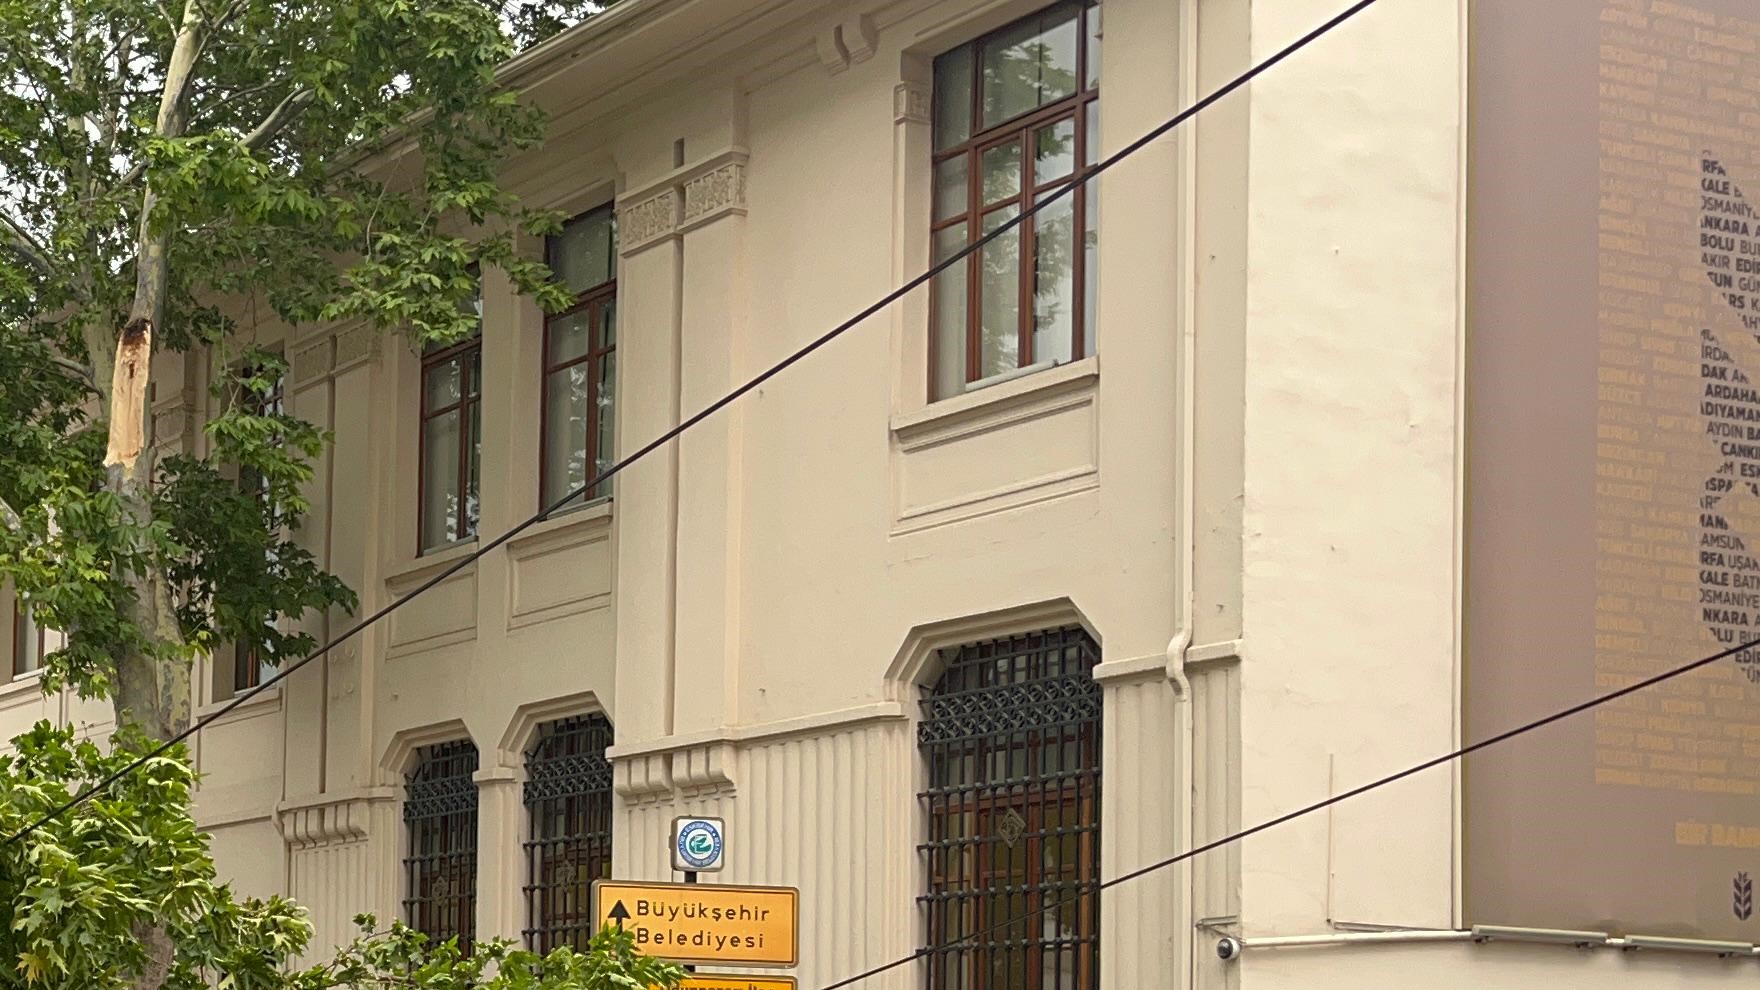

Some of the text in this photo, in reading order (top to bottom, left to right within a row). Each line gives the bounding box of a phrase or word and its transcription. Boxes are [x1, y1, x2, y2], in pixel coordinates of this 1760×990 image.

[1700, 233, 1734, 251] BOLU
[637, 900, 770, 922] Büyükşehir
[637, 927, 764, 952] Belediyesi
